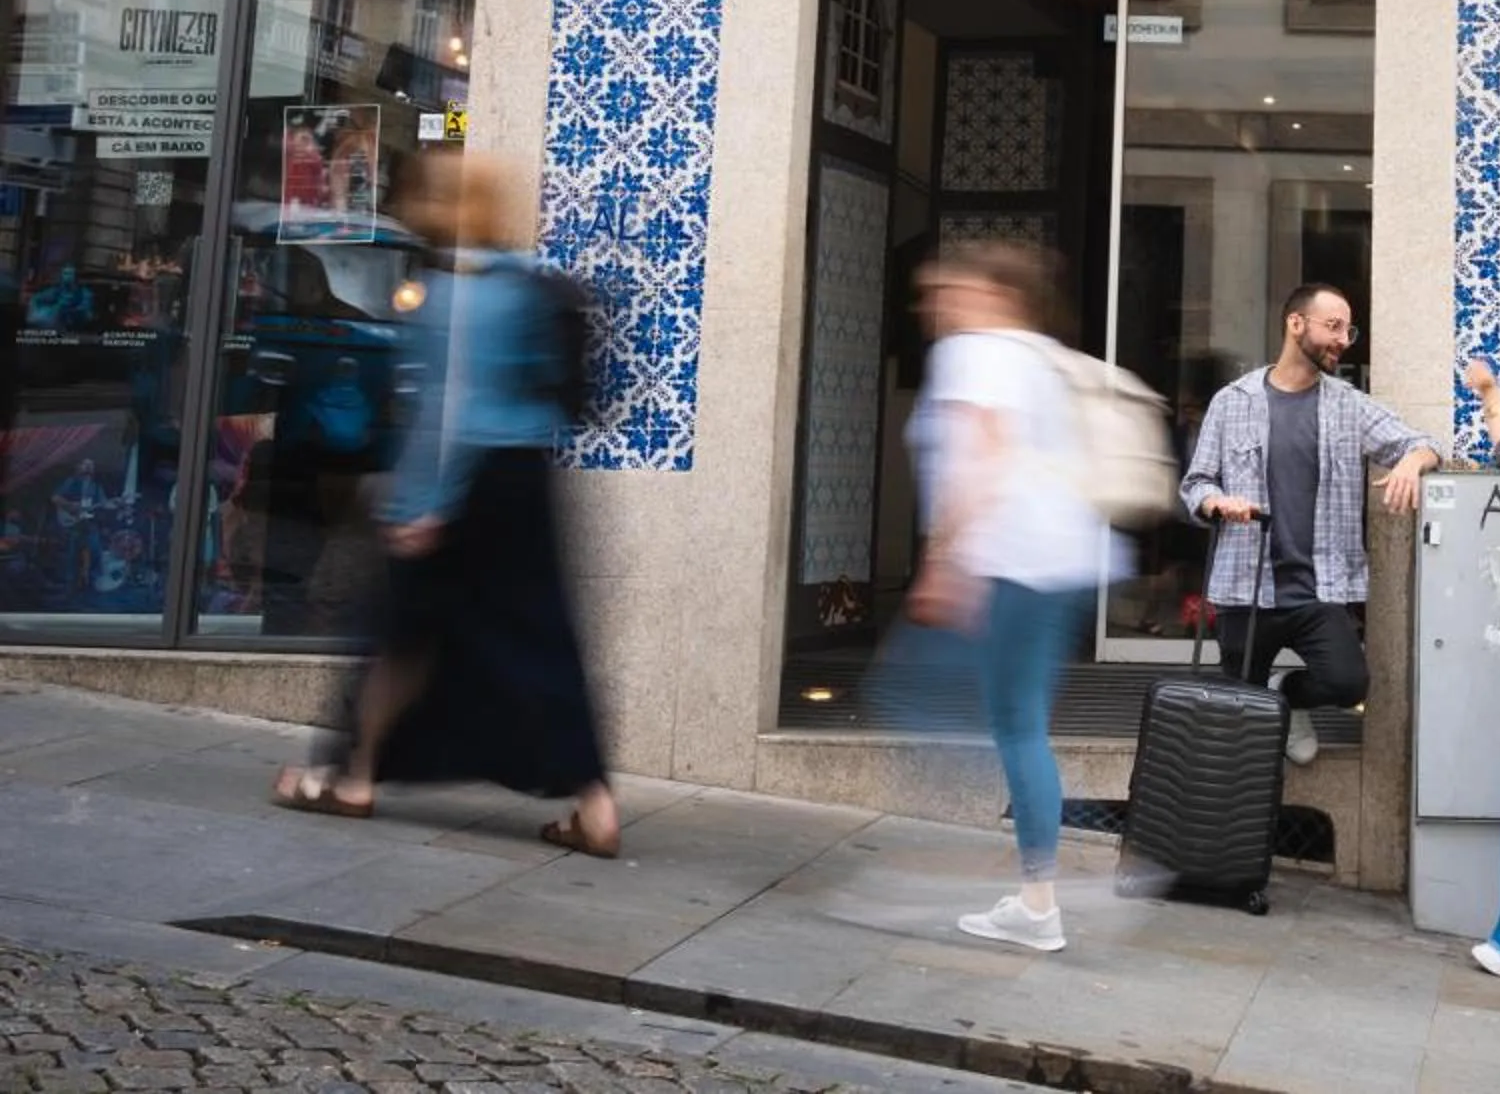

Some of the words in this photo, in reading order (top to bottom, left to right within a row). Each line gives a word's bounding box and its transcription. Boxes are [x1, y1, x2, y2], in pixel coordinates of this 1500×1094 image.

[119, 7, 218, 55] CITYNIZER
[98, 94, 178, 106] DESCOBRE
[181, 94, 193, 105] O
[128, 117, 138, 127] A
[135, 141, 157, 152] EM
[160, 141, 205, 153] BAIXO
